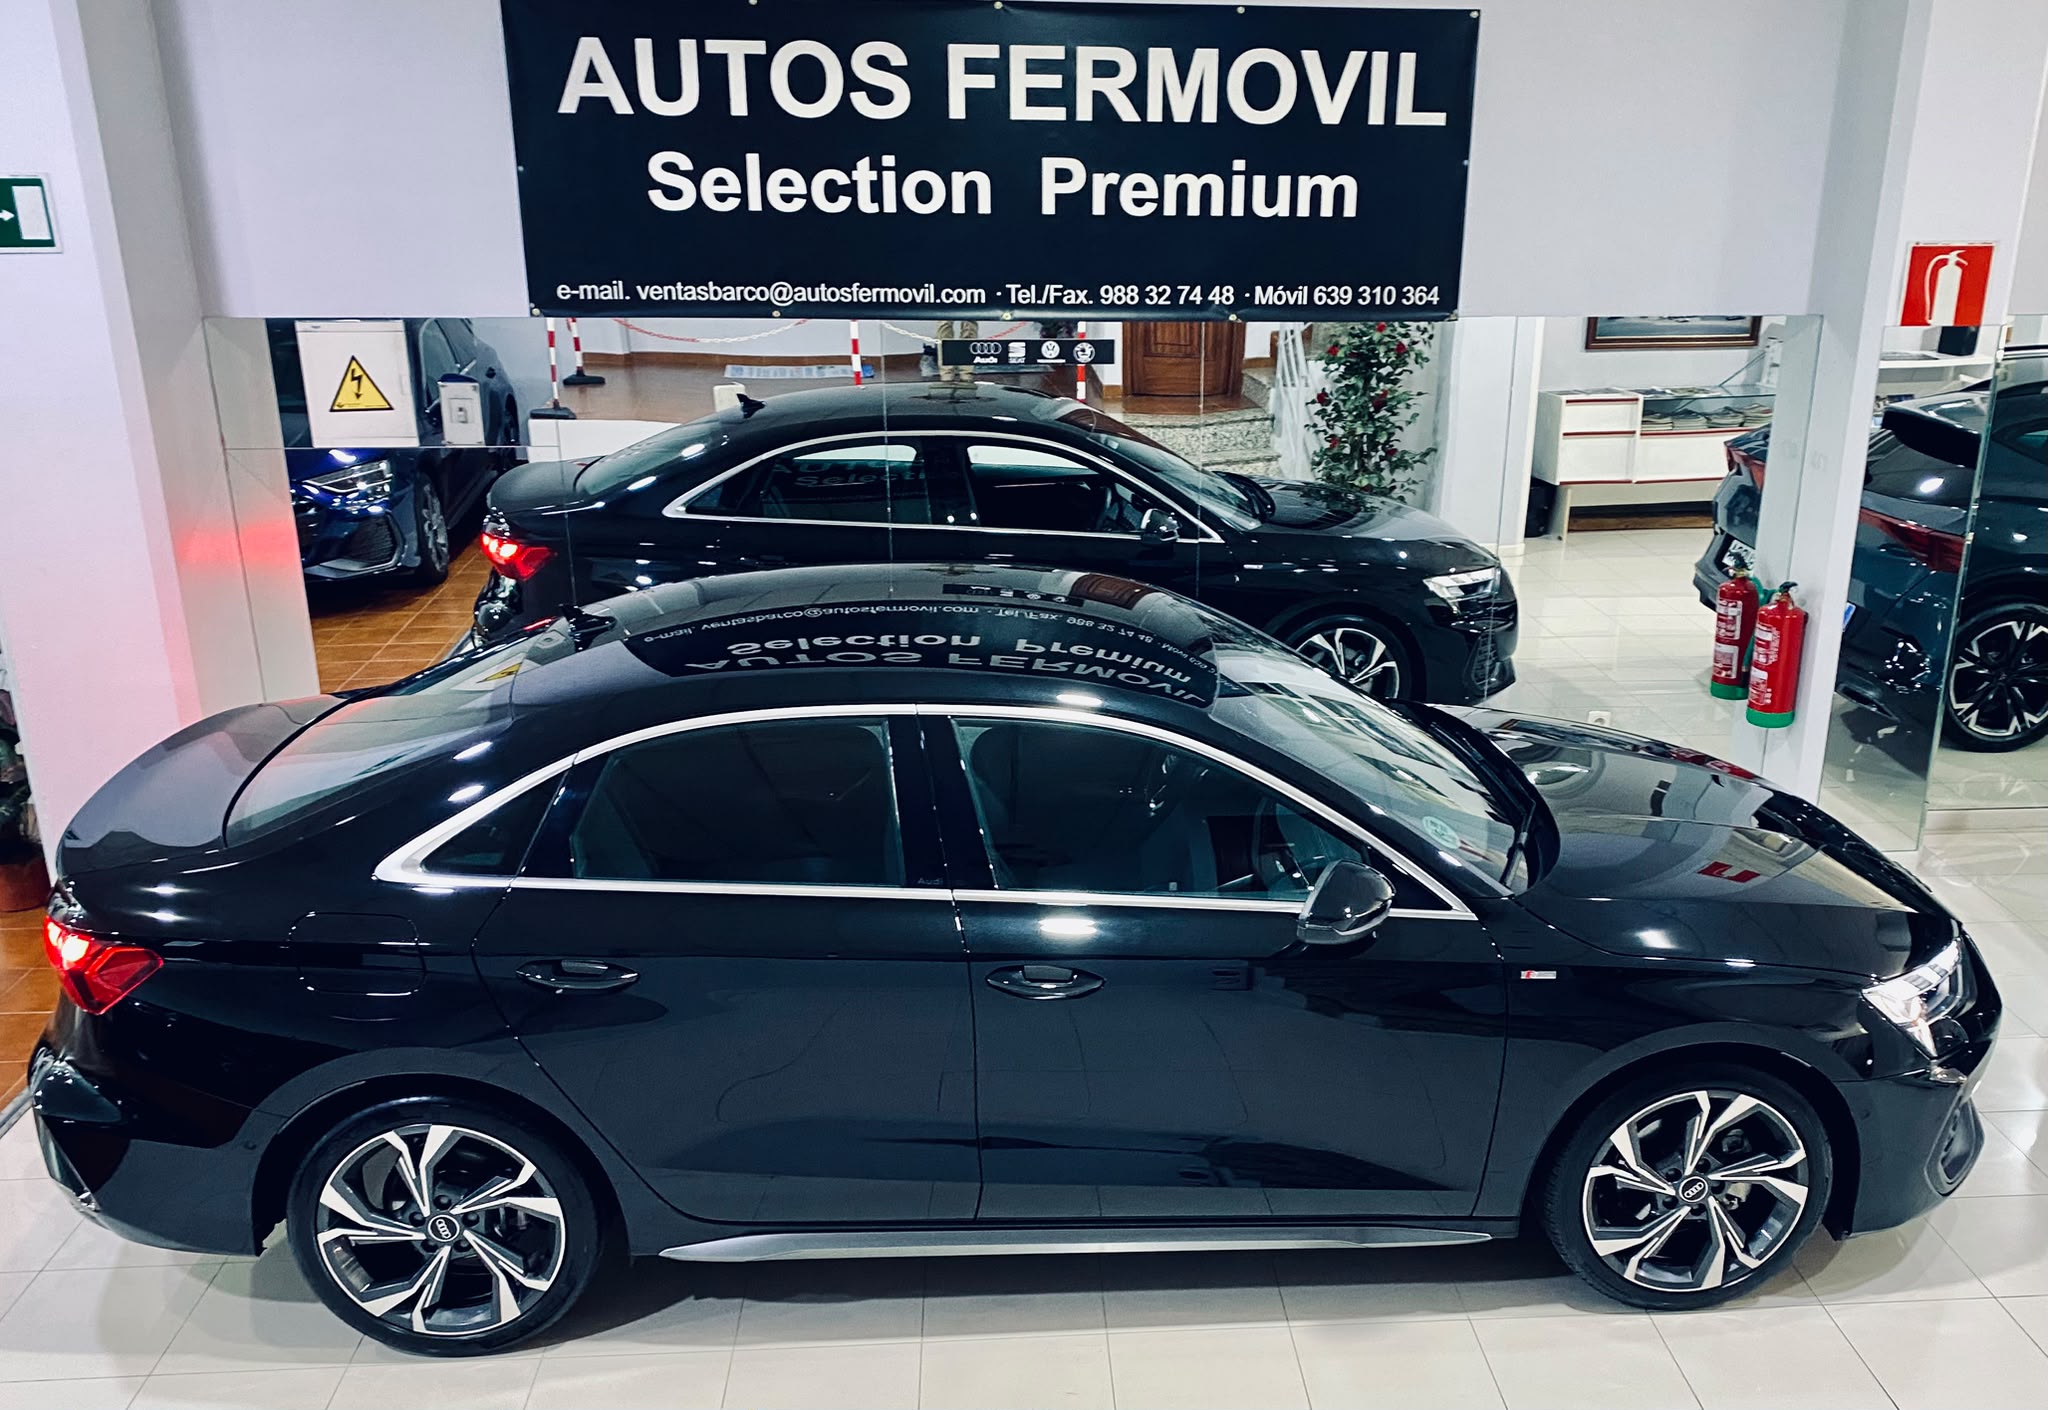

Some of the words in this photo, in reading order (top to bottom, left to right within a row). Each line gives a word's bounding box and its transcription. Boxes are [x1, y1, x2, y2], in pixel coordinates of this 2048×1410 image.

[557, 36, 911, 120] AUTOS
[946, 43, 1447, 127] FERMOVIL
[647, 150, 992, 215] Selection
[1040, 156, 1358, 218] Premium
[556, 280, 631, 301] e-mail.
[635, 280, 986, 307] ventasbarco@autosfermovil.com
[1099, 284, 1140, 305] 988
[1144, 284, 1172, 305] 32
[1176, 285, 1203, 305] 74
[1207, 285, 1235, 306] 48
[1313, 285, 1353, 306] 639
[1357, 285, 1397, 306] 310
[1401, 285, 1440, 306] 364
[972, 356, 999, 364] Audi
